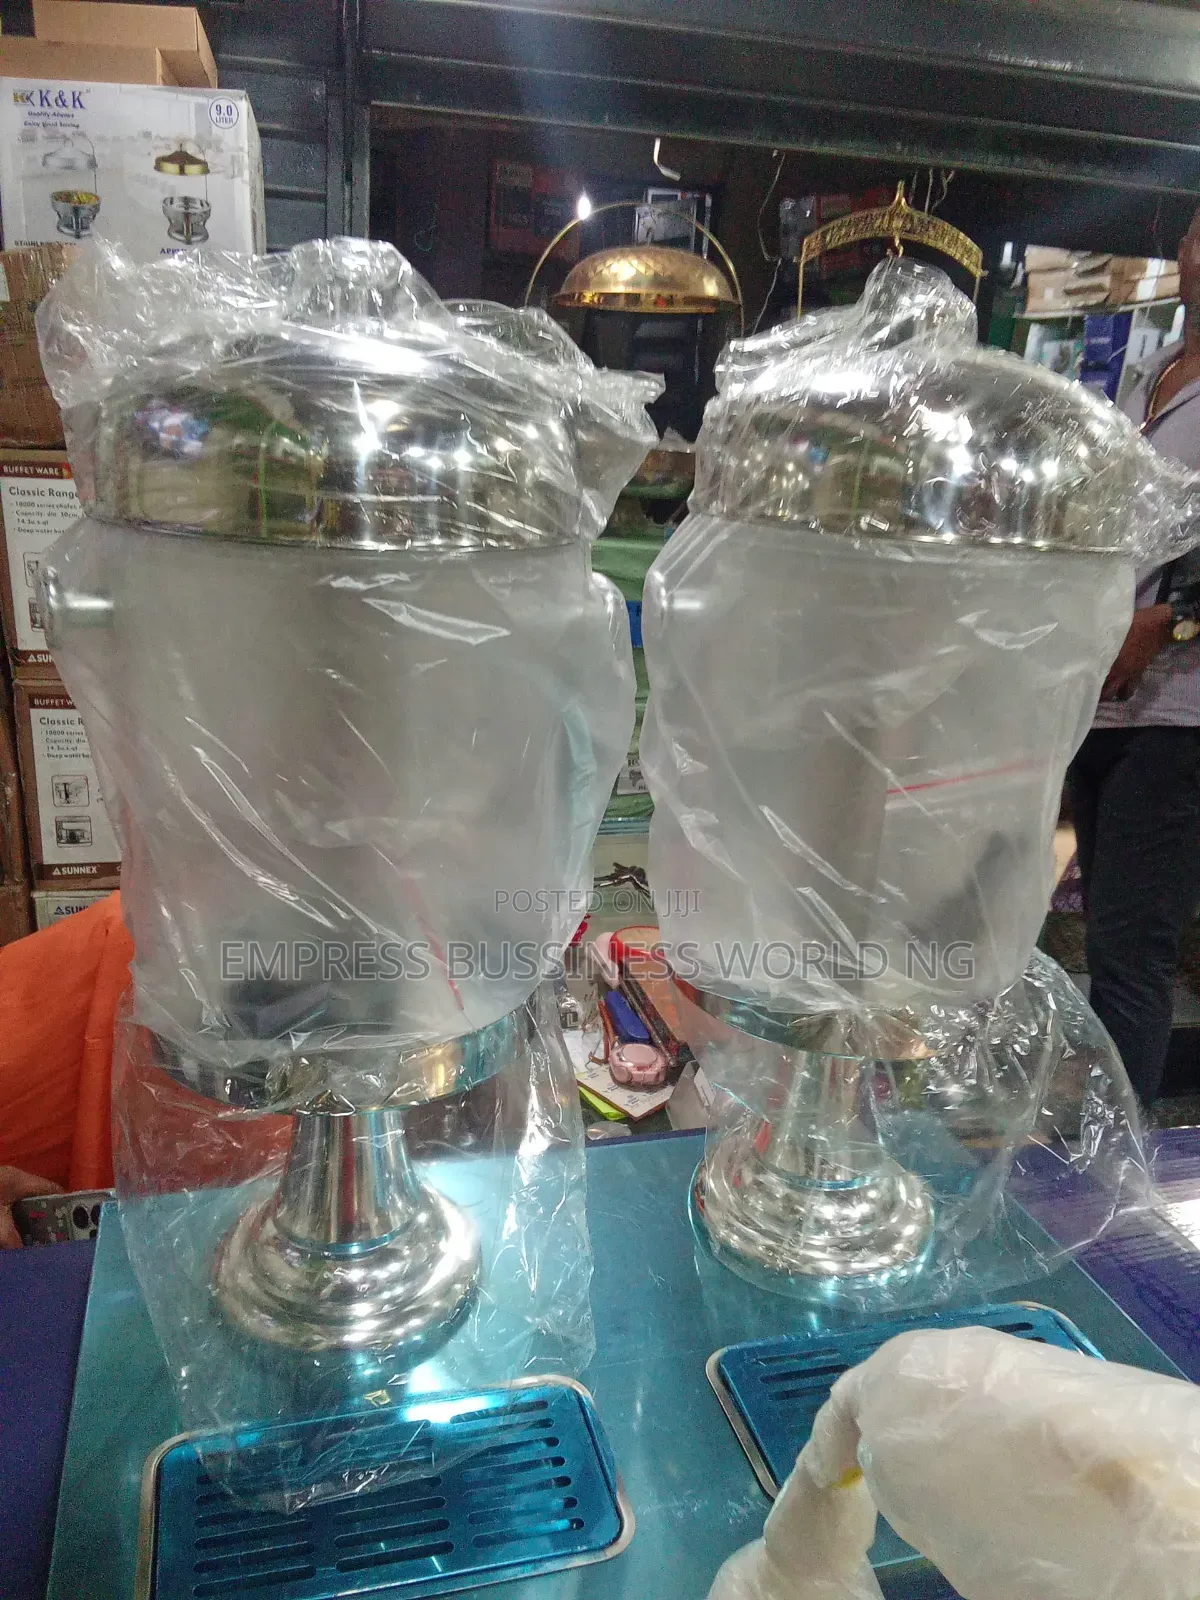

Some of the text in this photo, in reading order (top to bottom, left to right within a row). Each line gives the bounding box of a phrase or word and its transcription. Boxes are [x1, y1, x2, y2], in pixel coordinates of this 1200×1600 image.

[39, 89, 51, 107] K
[54, 89, 68, 108] &
[72, 90, 86, 109] K
[215, 104, 233, 116] 9.0
[3, 465, 60, 476] BUFFET WARE
[9, 486, 46, 497] Classic
[34, 698, 64, 706] BUFFET
[40, 716, 76, 726] Classic
[61, 865, 97, 875] SUNNEX
